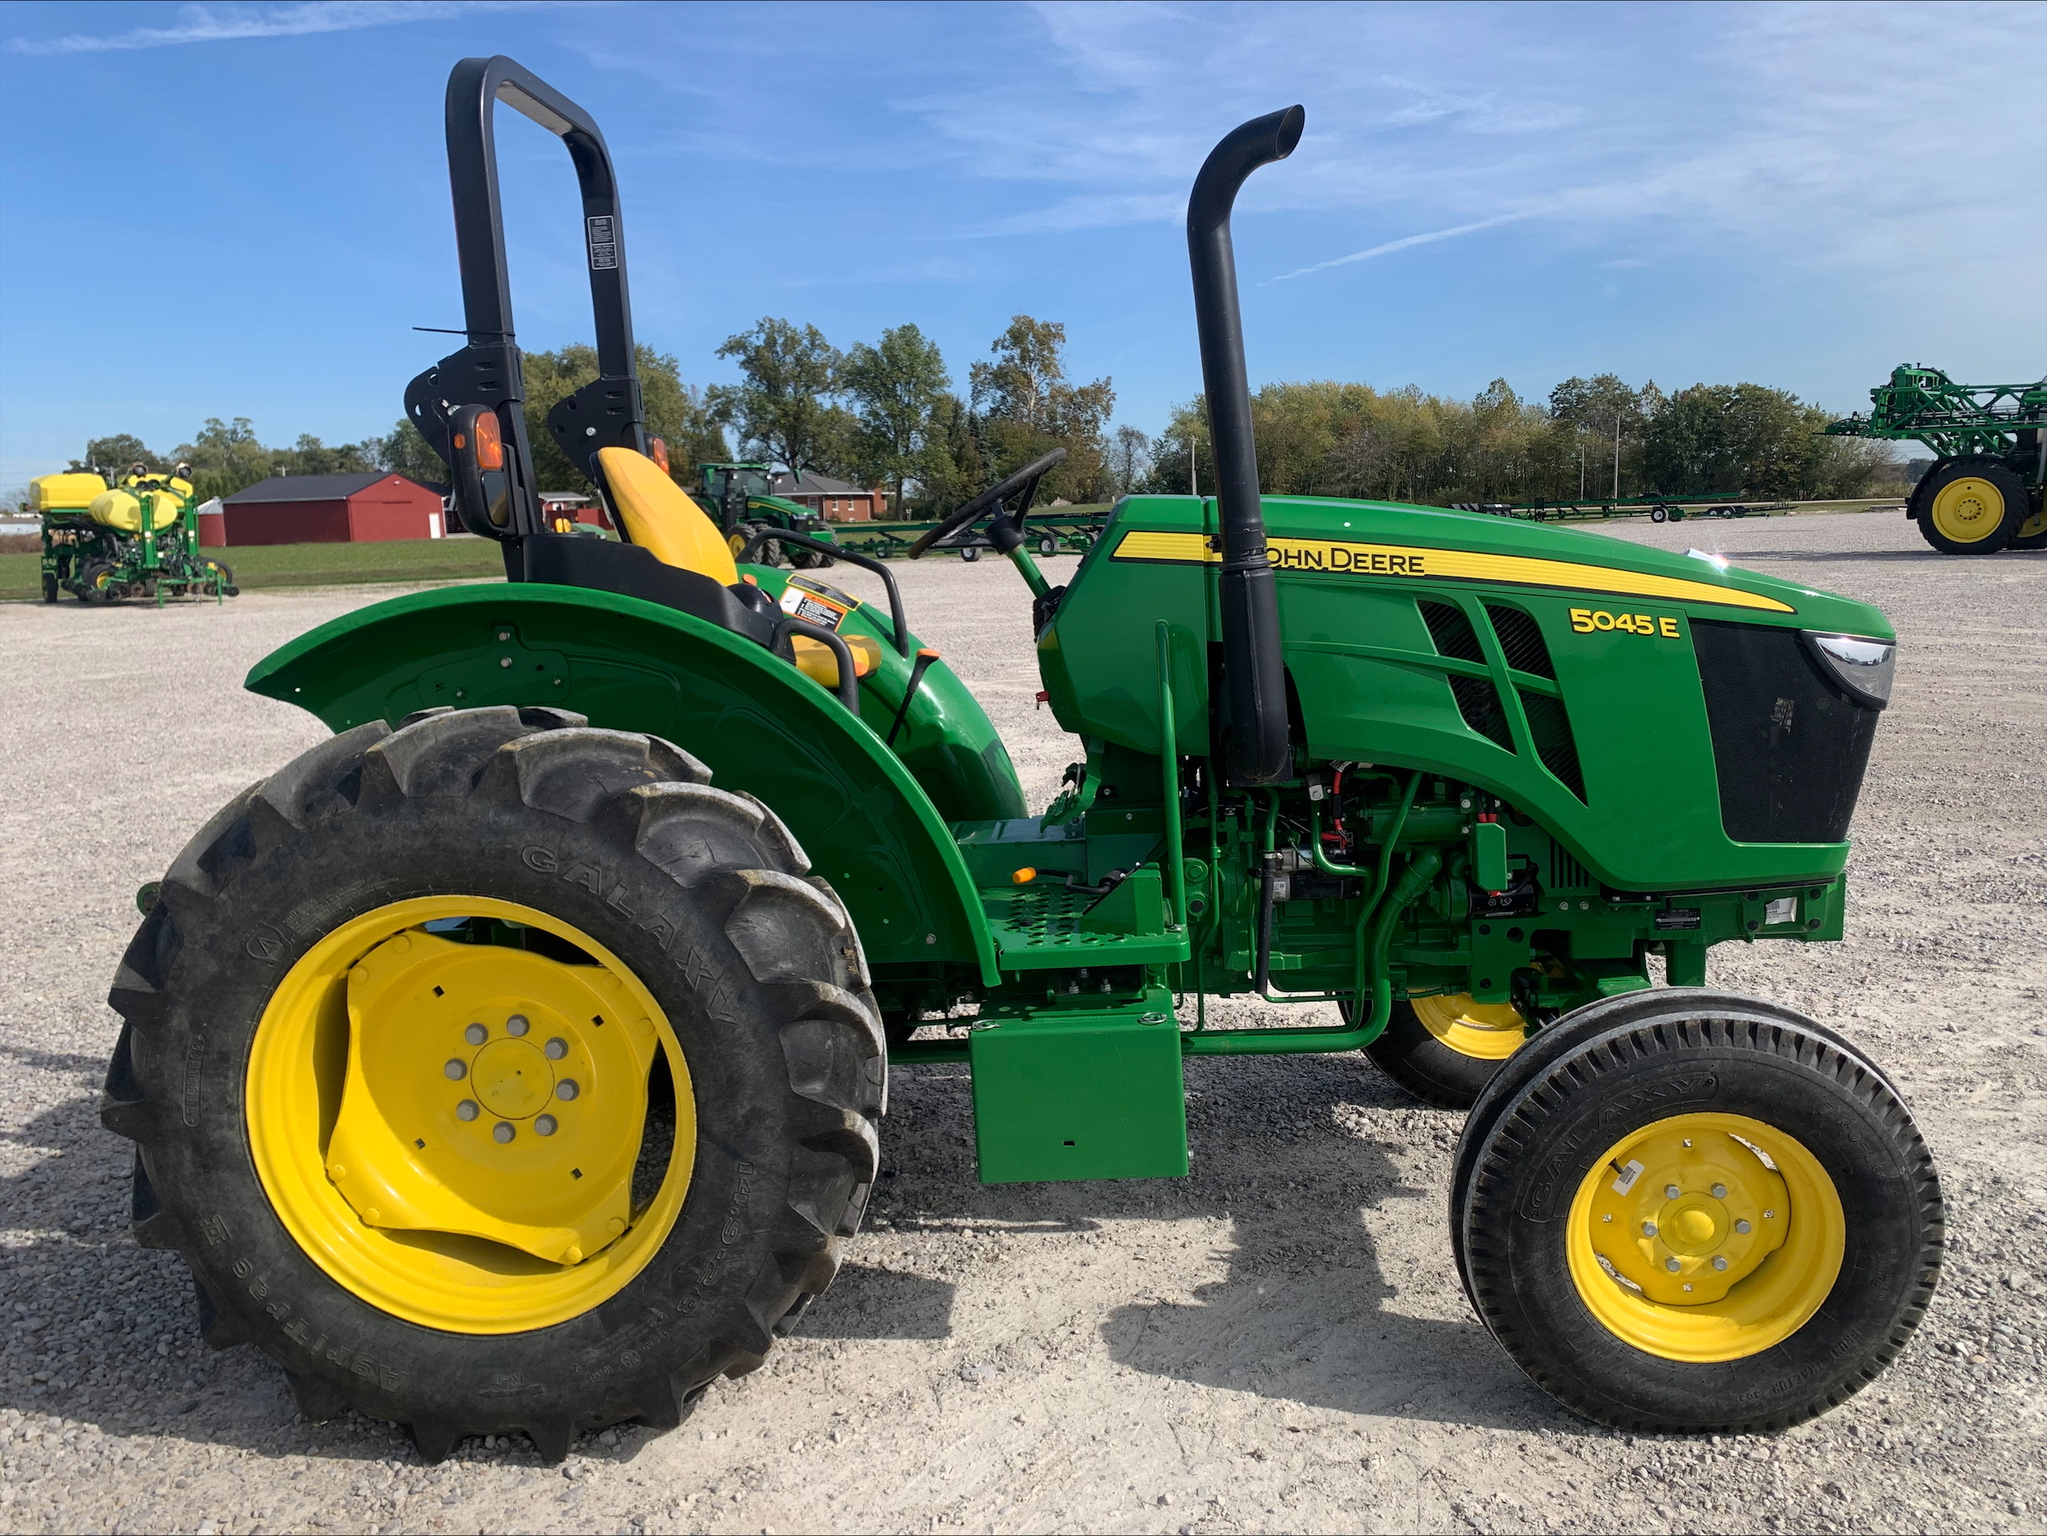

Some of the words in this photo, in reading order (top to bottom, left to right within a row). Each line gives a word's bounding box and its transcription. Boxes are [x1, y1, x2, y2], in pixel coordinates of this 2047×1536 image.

[1266, 547, 1323, 568] OHN
[1330, 547, 1425, 574] DEERE
[1568, 607, 1655, 635] 5045
[1658, 616, 1681, 639] E
[521, 844, 739, 1025] GALAXY
[1531, 1075, 1704, 1208] GALAXY
[676, 1161, 755, 1314] 14.9-28
